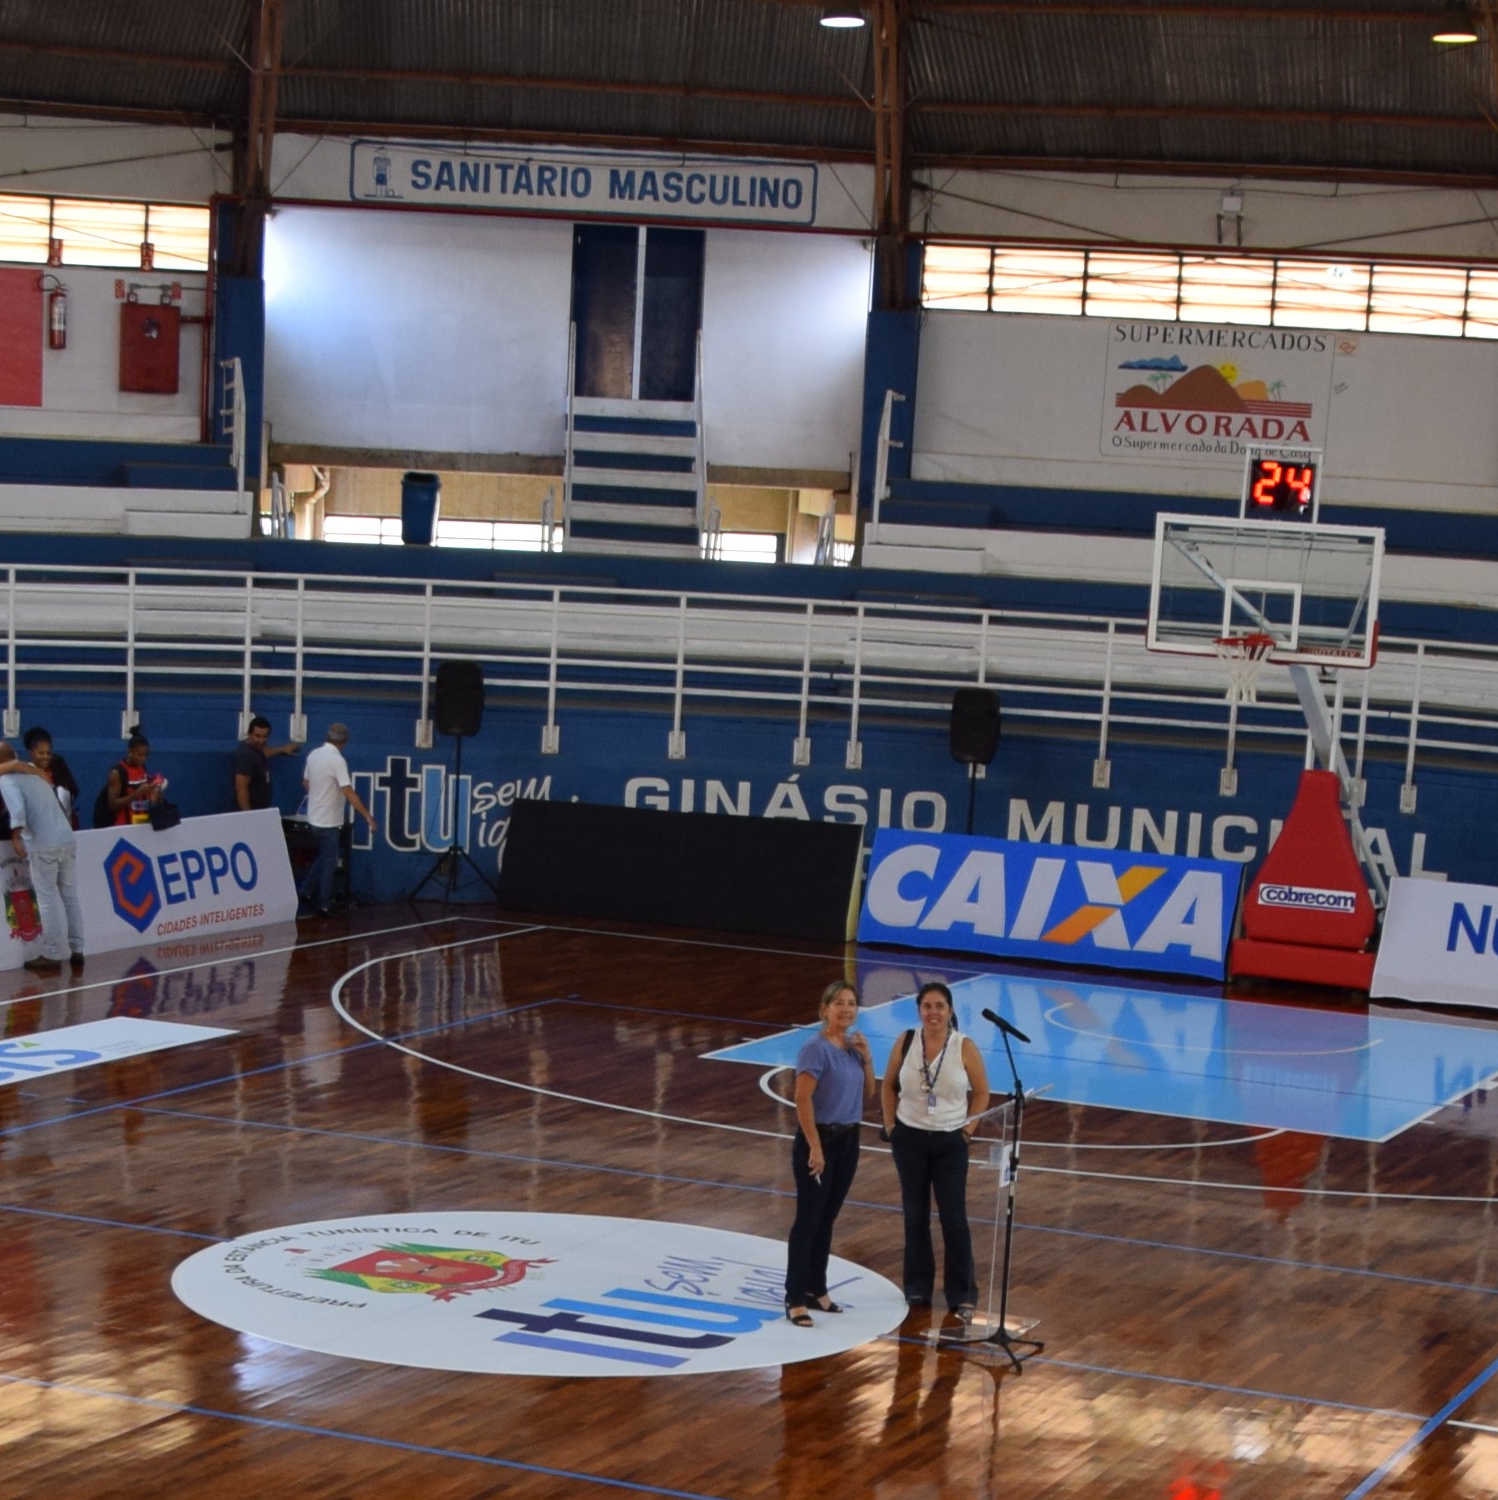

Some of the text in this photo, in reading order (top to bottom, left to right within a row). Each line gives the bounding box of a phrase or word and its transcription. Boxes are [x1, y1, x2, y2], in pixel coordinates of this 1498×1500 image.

[608, 168, 803, 209] MASCULINO
[1114, 324, 1327, 353] SUPERMERCADOS
[1113, 410, 1312, 442] ALVORADA
[1124, 436, 1213, 454] Supermercado
[1253, 461, 1313, 505] 24
[623, 774, 948, 835] GINÁSIO
[157, 842, 258, 905] EPPO
[865, 843, 1224, 963] CAIXA
[1265, 886, 1356, 910] cobrecom
[157, 904, 265, 936] CIDADES INTELIGENTES
[299, 1226, 439, 1238] TURÍSTICA
[453, 1229, 490, 1238] DE
[498, 1234, 541, 1246] ITU
[235, 1275, 368, 1309] PREFEITURA
